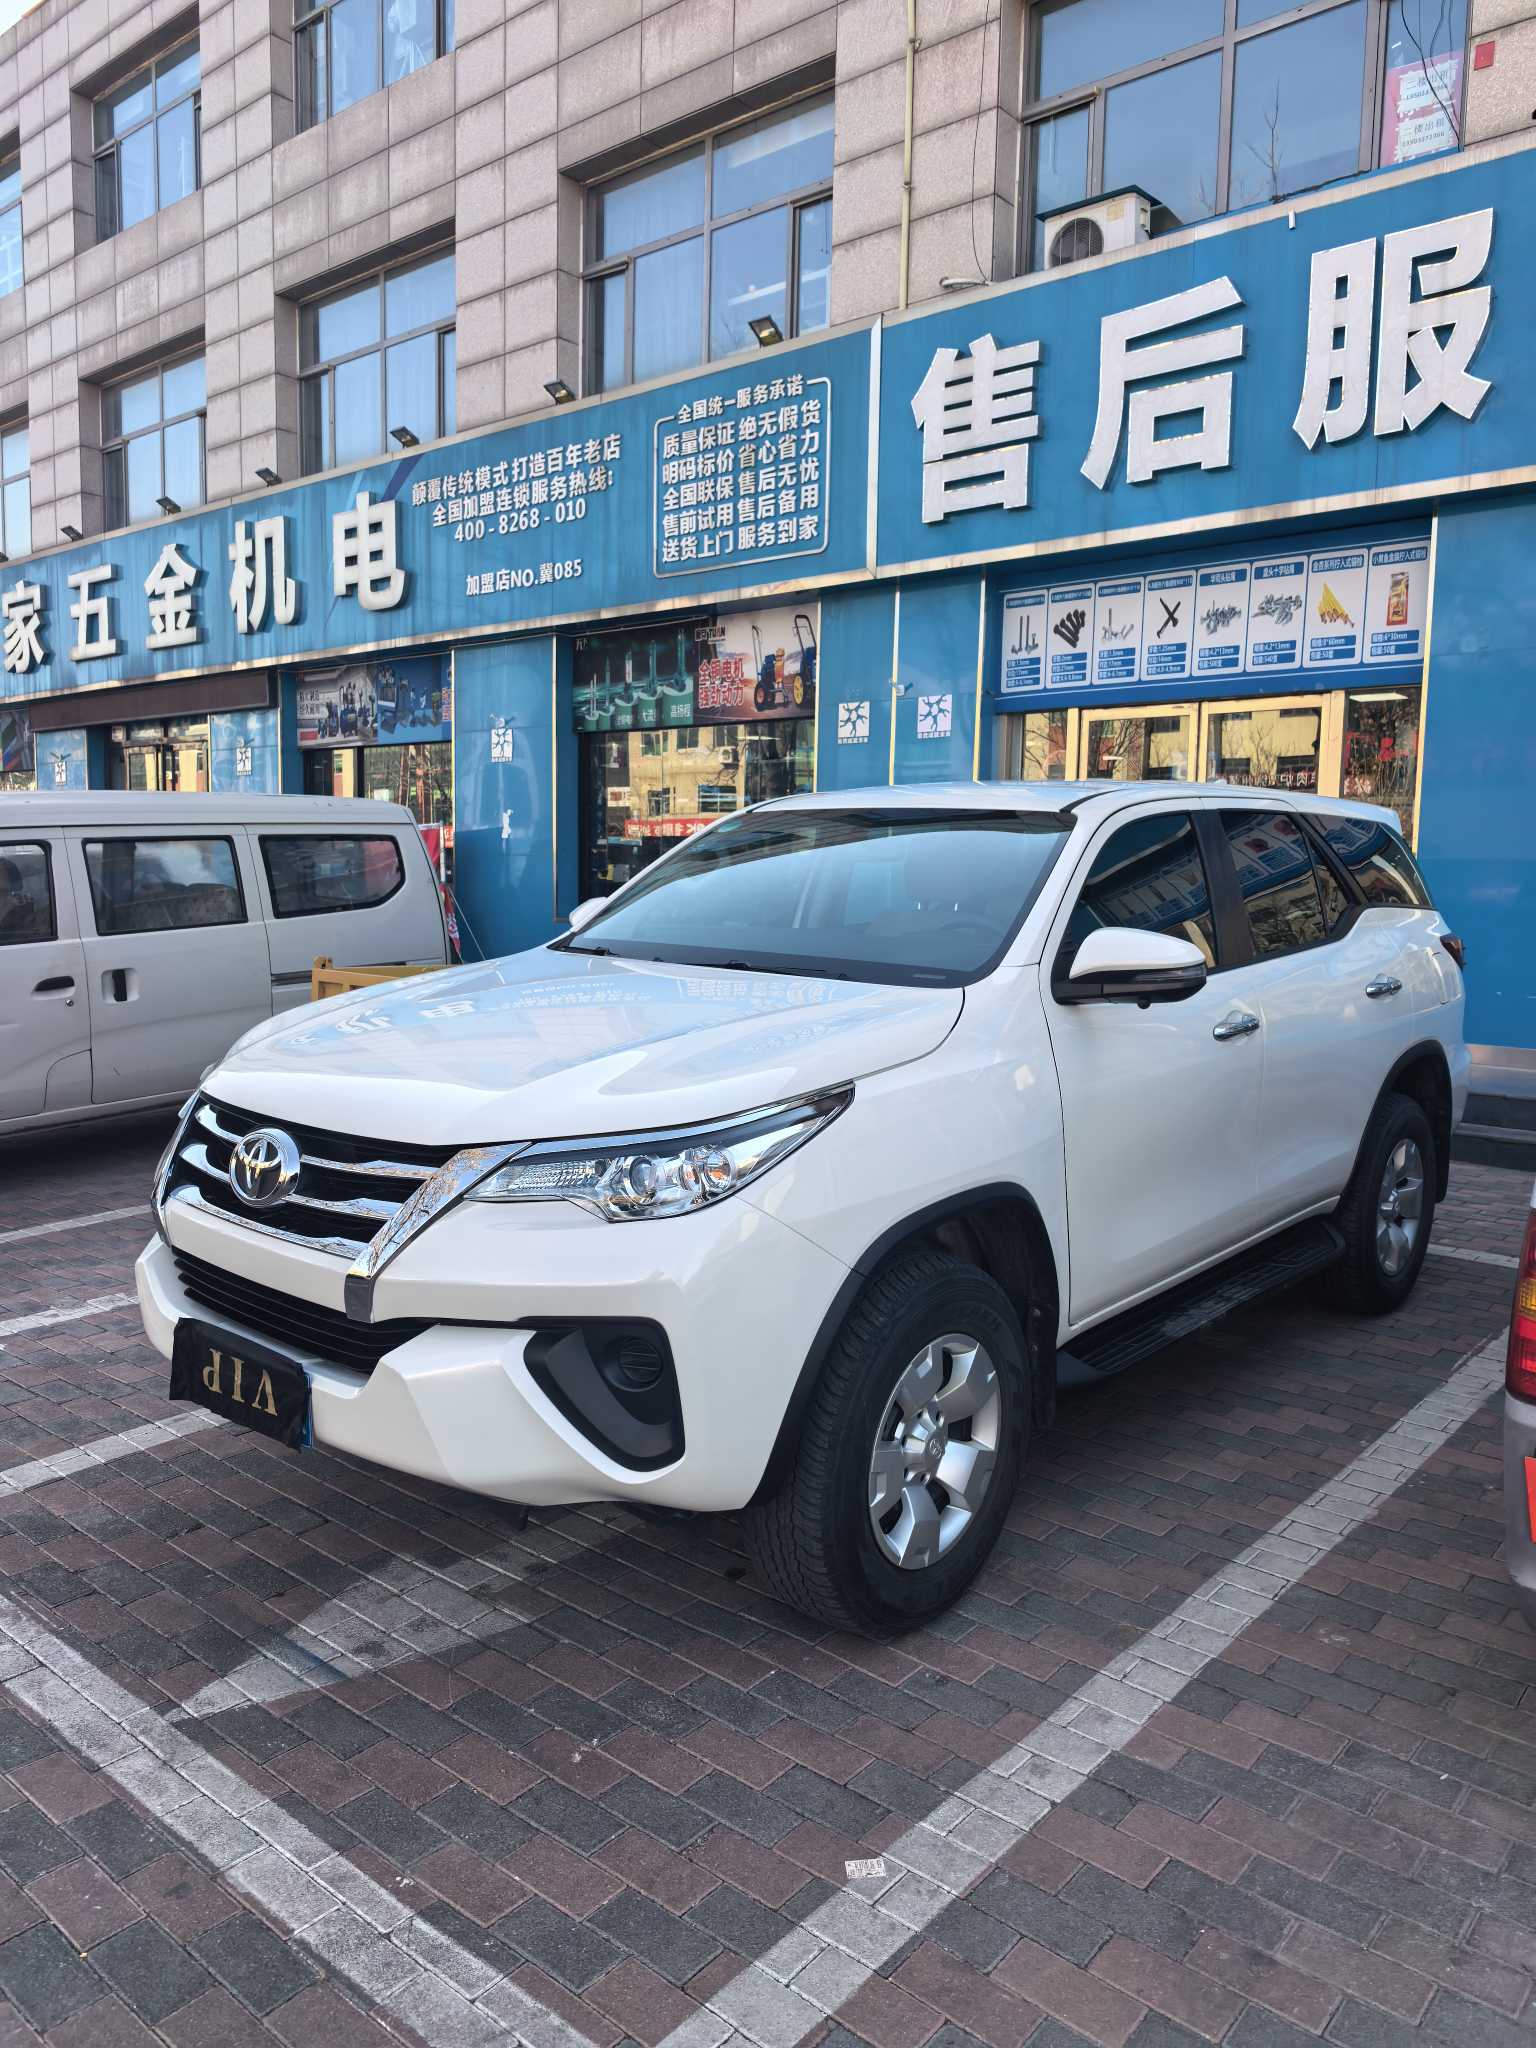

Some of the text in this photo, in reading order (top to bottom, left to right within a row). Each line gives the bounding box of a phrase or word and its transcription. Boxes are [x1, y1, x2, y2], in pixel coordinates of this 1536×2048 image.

[911, 208, 1494, 524] 售后服
[678, 375, 804, 425] 全国统一服务承诺
[662, 400, 821, 460] 质量保证 绝无假货
[662, 429, 820, 485] 明码标价 省心省力
[411, 434, 621, 506] 颠覆传统模式 打造百年老店
[662, 459, 819, 511] 全国联保 售后无忧
[662, 485, 819, 538] 售前试用 售后备用
[662, 515, 819, 563] 送货上门 服务到家
[2, 491, 406, 674] 家五金机电
[202, 1348, 278, 1416] VIP
